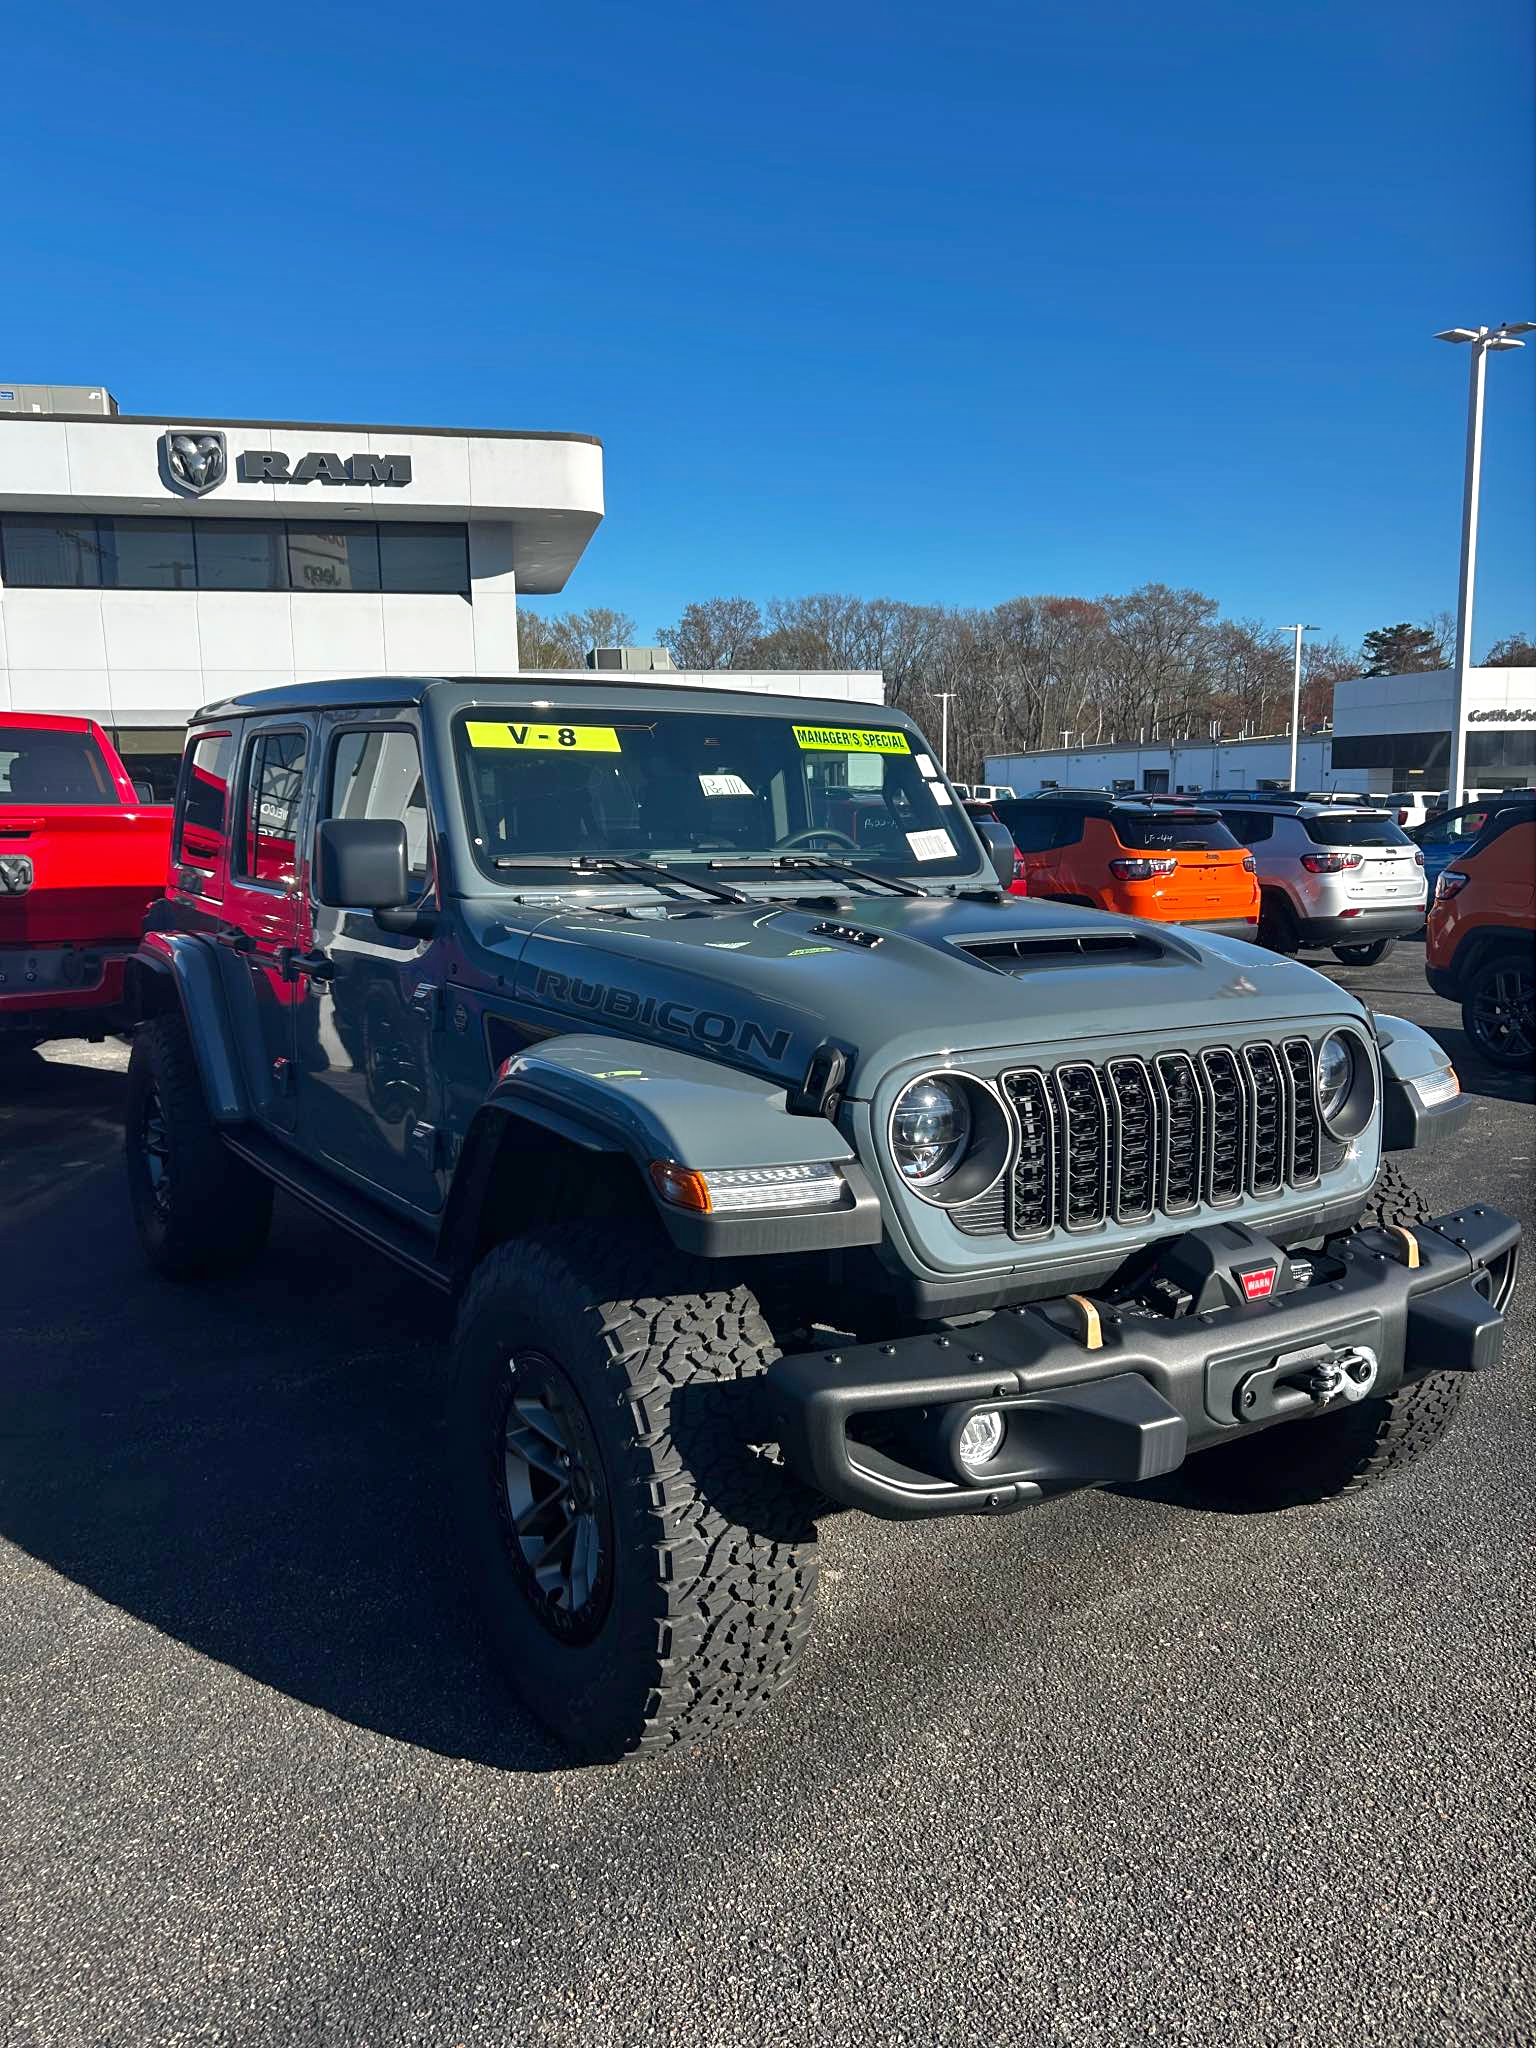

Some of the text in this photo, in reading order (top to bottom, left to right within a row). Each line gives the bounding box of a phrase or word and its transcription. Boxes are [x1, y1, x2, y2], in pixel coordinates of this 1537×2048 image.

[236, 449, 413, 487] RAM
[796, 729, 905, 748] MANAGER'S SPECIAL
[535, 967, 793, 1062] RUBICON
[1247, 1277, 1271, 1291] WARN
